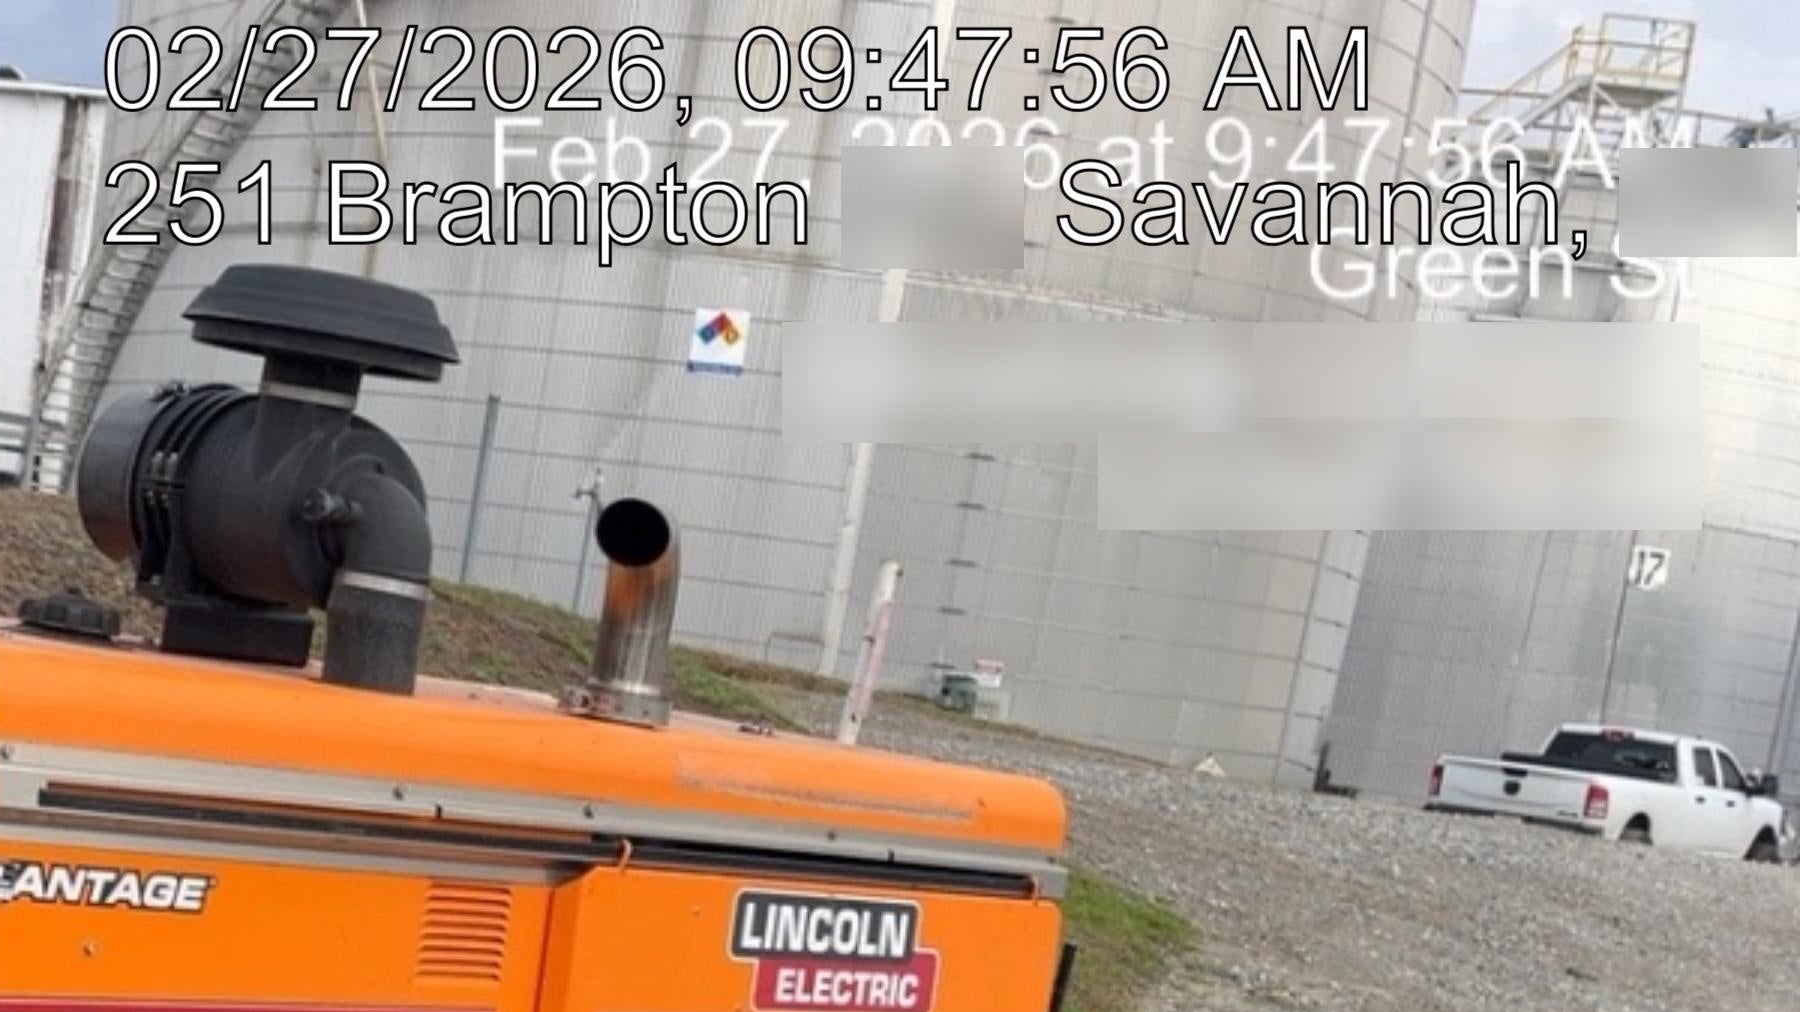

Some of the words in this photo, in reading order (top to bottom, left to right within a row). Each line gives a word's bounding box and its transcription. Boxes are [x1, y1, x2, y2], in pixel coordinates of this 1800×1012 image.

[1634, 550, 1666, 585] 17
[739, 901, 910, 958] LINCOLN
[773, 967, 921, 1008] ELECTRIC
